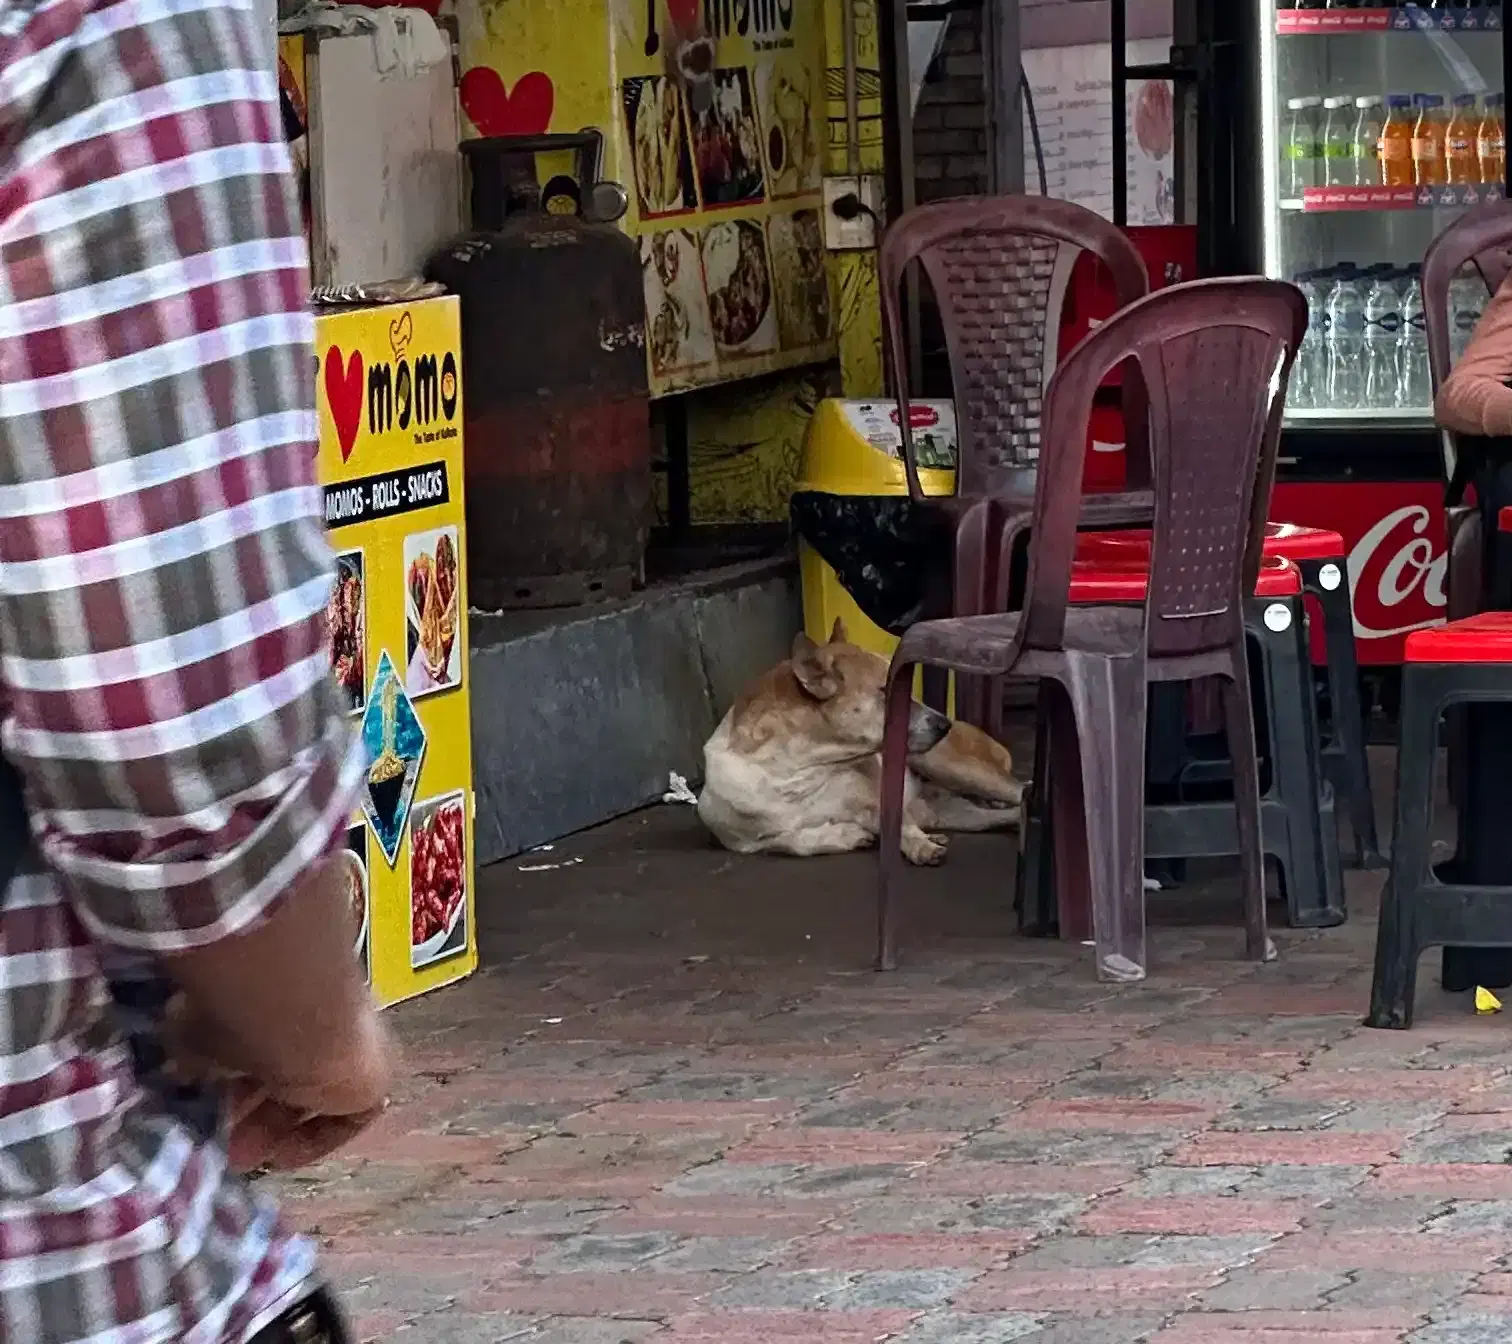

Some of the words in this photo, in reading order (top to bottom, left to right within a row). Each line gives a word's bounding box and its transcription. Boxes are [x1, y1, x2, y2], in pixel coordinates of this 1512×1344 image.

[368, 351, 457, 435] momo
[326, 486, 364, 520] MOMOS
[372, 478, 400, 511] ROLLS
[408, 470, 442, 503] SNACKS
